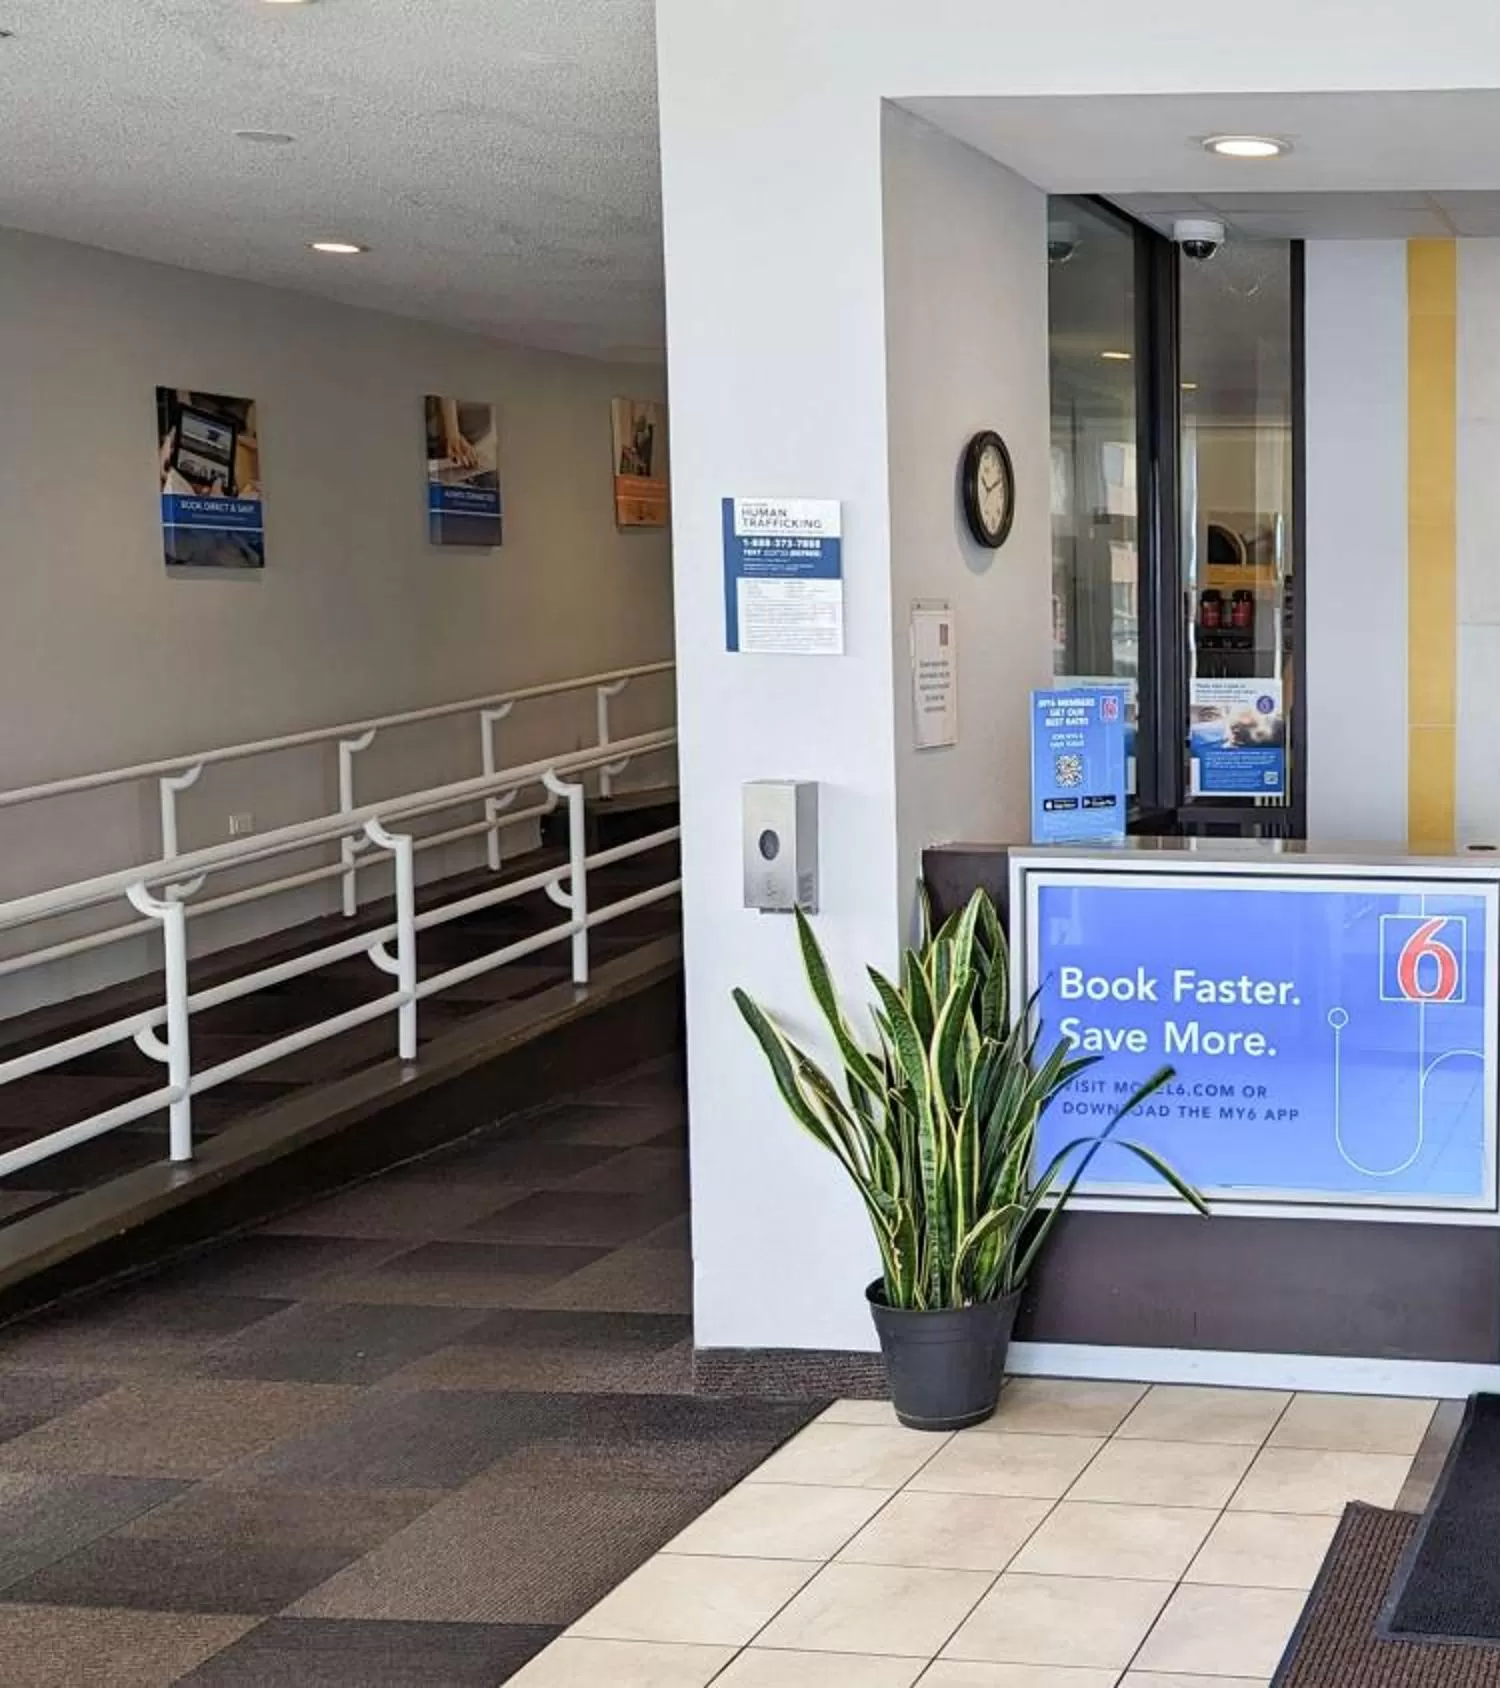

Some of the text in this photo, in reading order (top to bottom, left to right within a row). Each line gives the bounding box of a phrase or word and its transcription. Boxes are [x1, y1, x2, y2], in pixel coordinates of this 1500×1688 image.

[741, 508, 787, 517] HUMAN
[742, 519, 822, 529] TRAFFICKING
[1397, 916, 1460, 1002] 6
[1059, 966, 1300, 1005] Book Faster.
[1059, 1017, 1276, 1056] Save More.
[1242, 1085, 1268, 1098] OR
[1063, 1101, 1299, 1121] DOWNOAD THE MY6 APP
